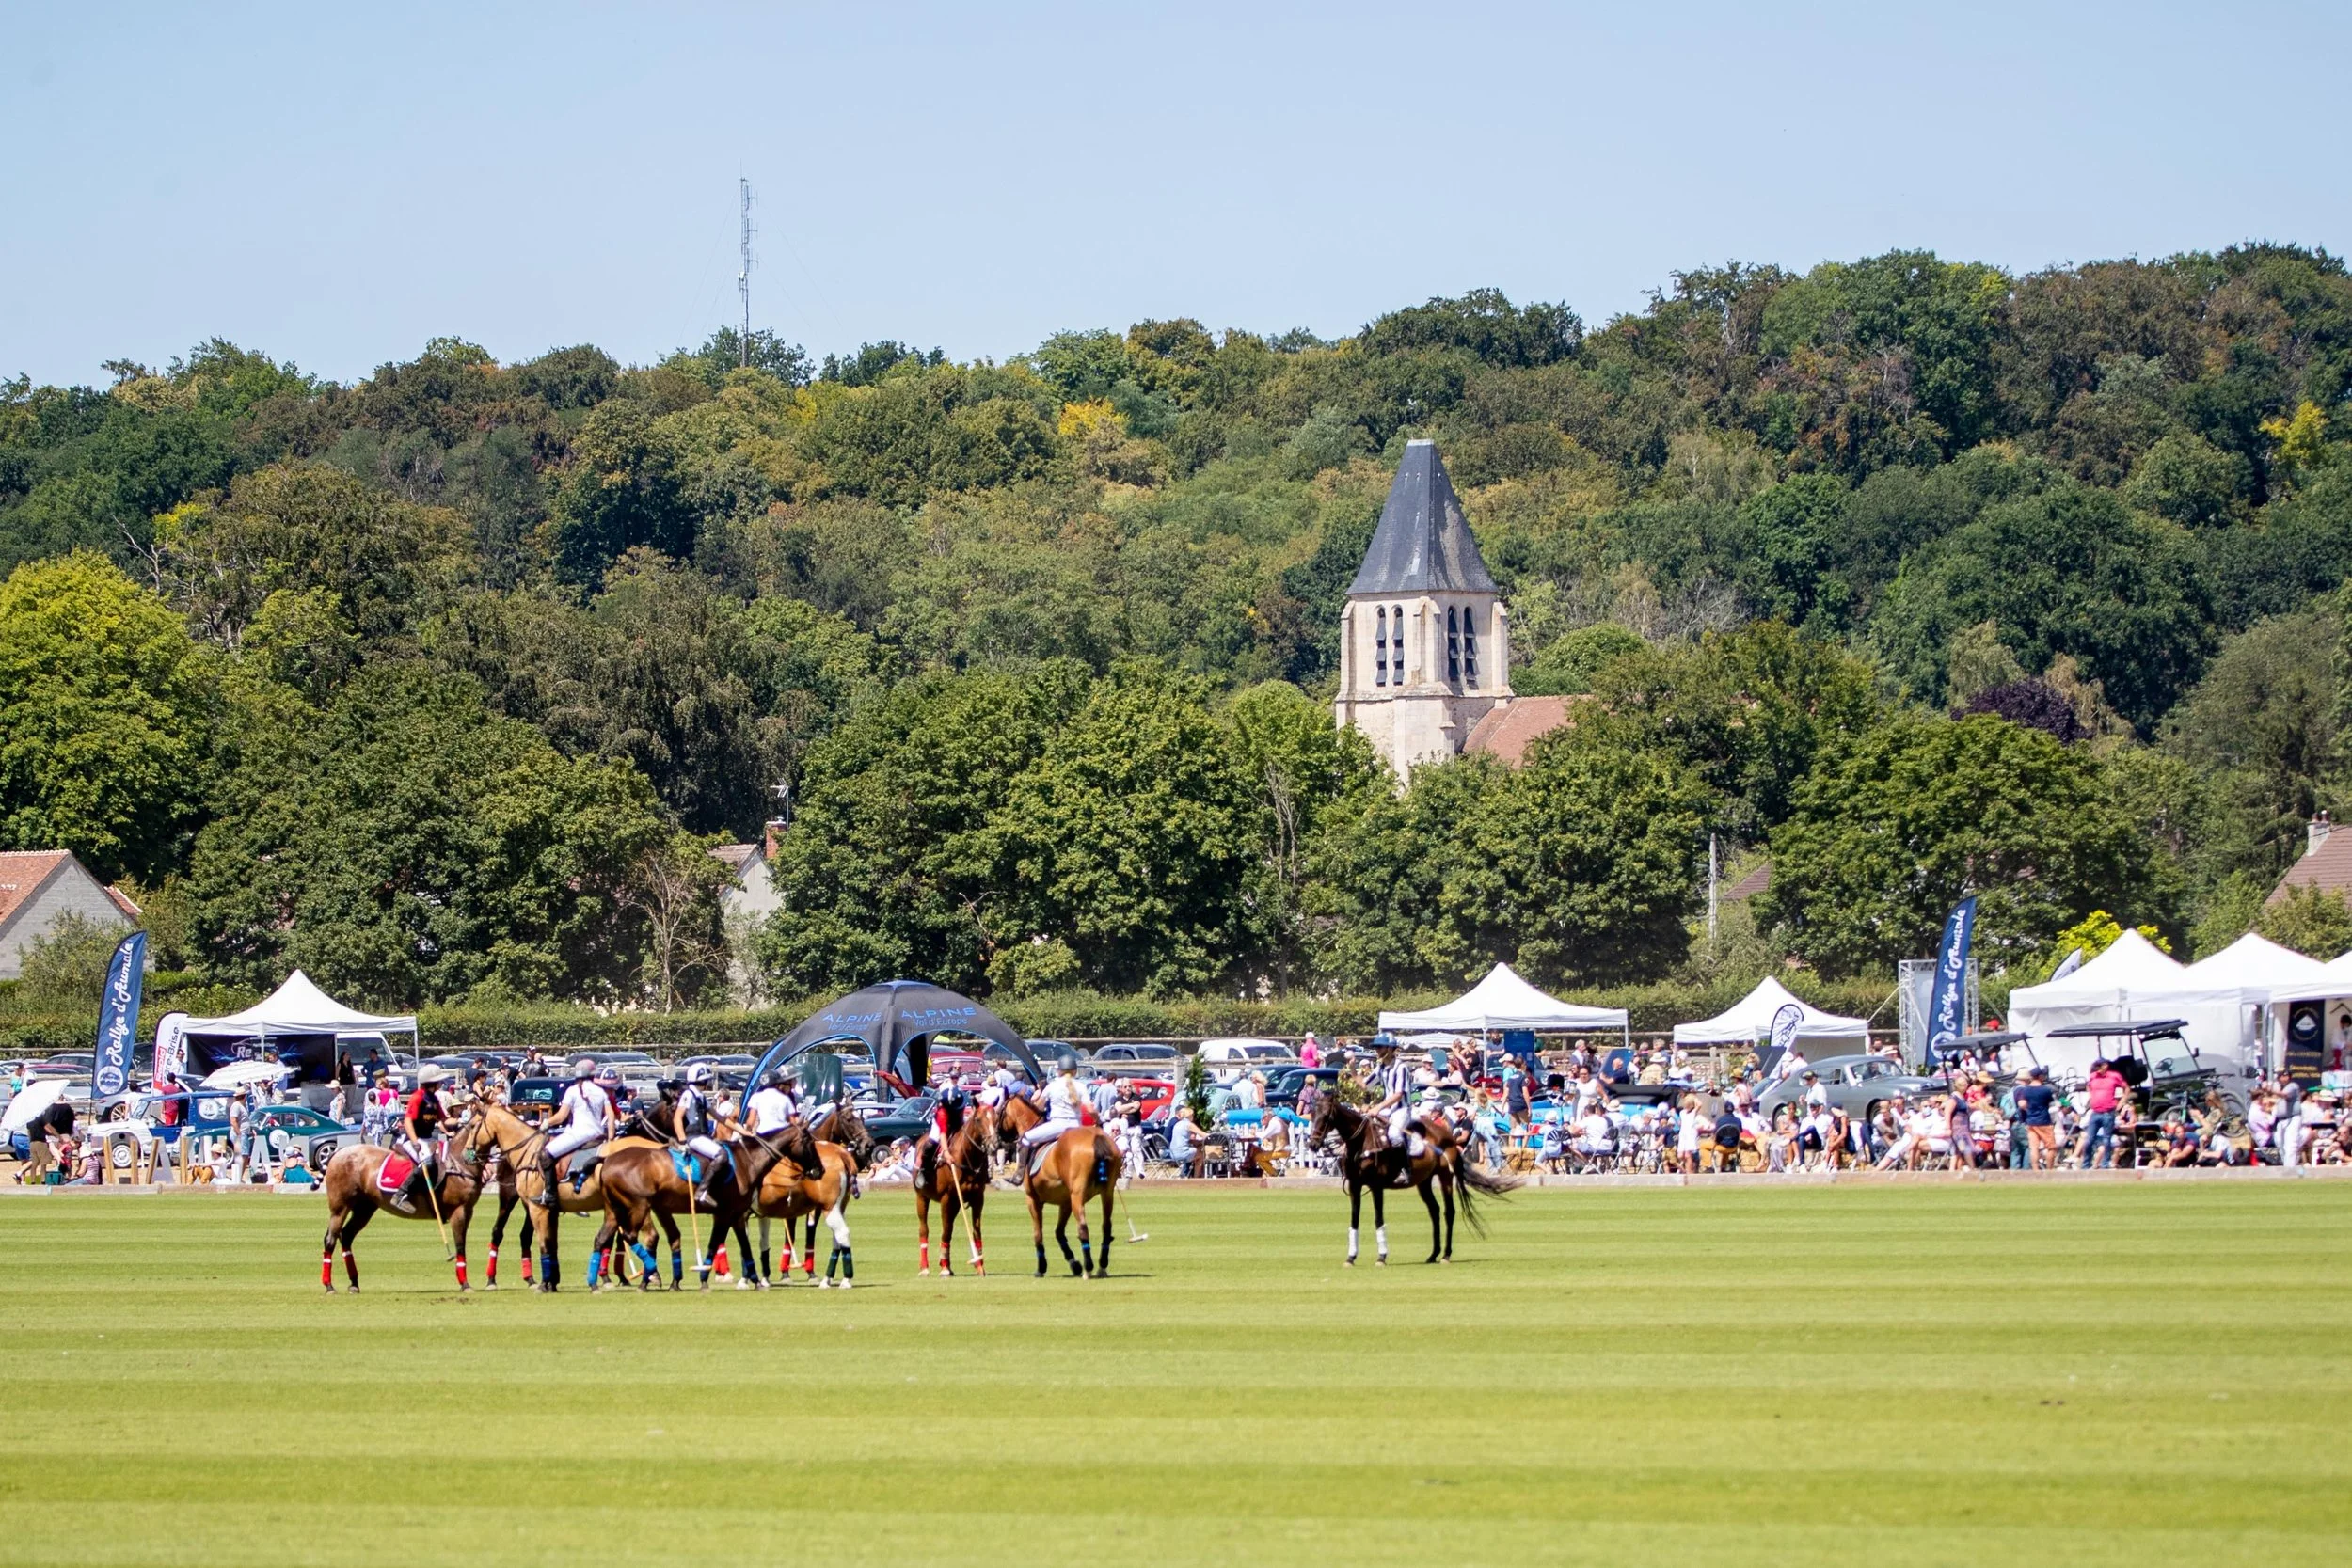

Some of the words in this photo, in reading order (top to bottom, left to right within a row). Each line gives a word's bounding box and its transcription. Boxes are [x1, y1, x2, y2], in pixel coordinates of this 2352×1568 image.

[111, 942, 134, 1012] d'Aumale
[821, 1012, 882, 1023] ALPINE
[901, 1007, 977, 1019] ALPINE
[1938, 982, 1958, 1031] Rallye
[105, 1015, 129, 1066] Rallye
